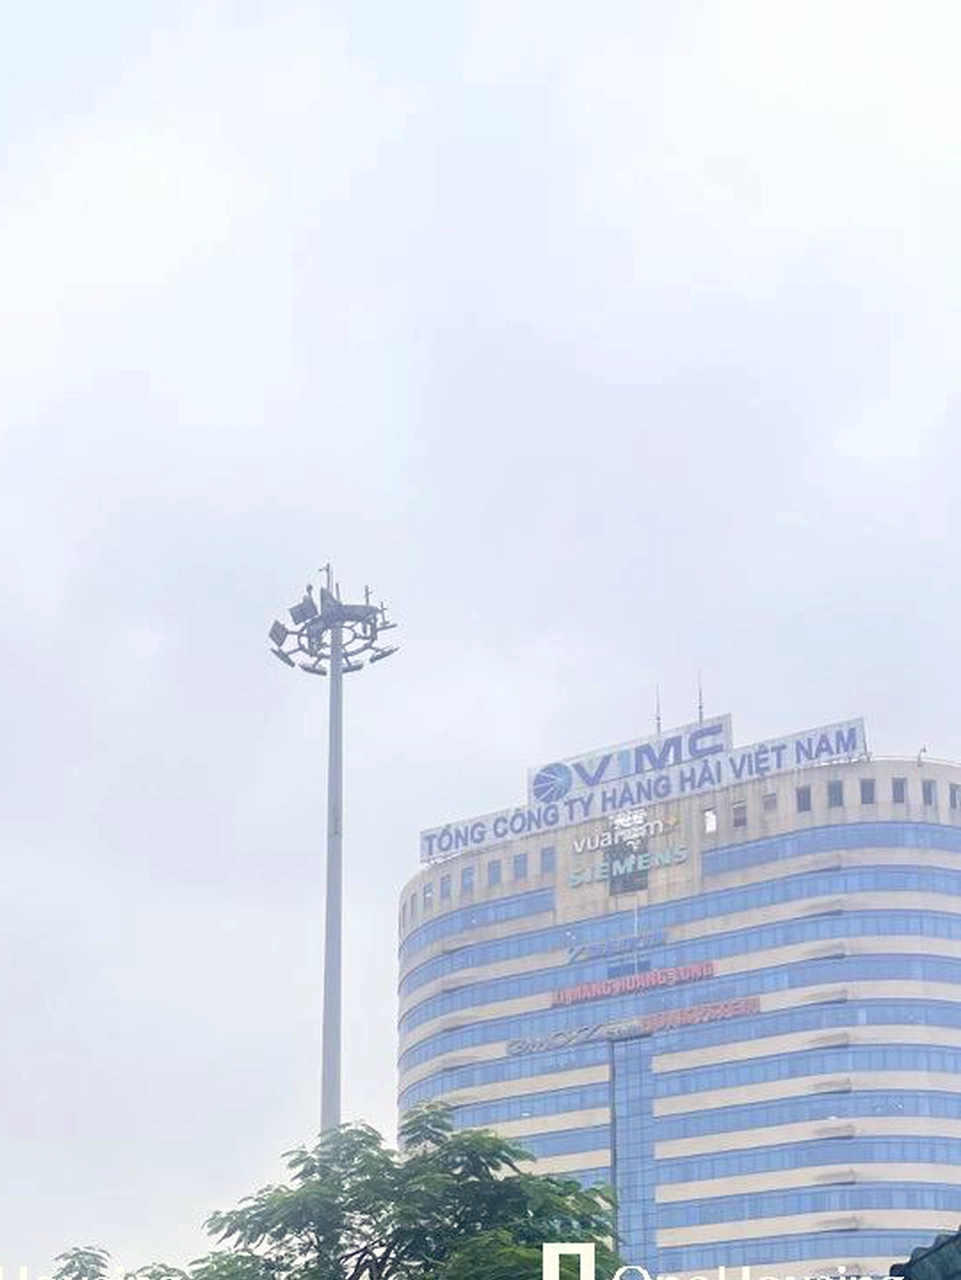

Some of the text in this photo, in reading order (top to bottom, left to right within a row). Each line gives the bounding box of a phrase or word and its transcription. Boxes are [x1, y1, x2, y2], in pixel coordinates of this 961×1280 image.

[564, 793, 594, 822] TY
[794, 727, 857, 764] NAM
[571, 723, 724, 787] VIMC
